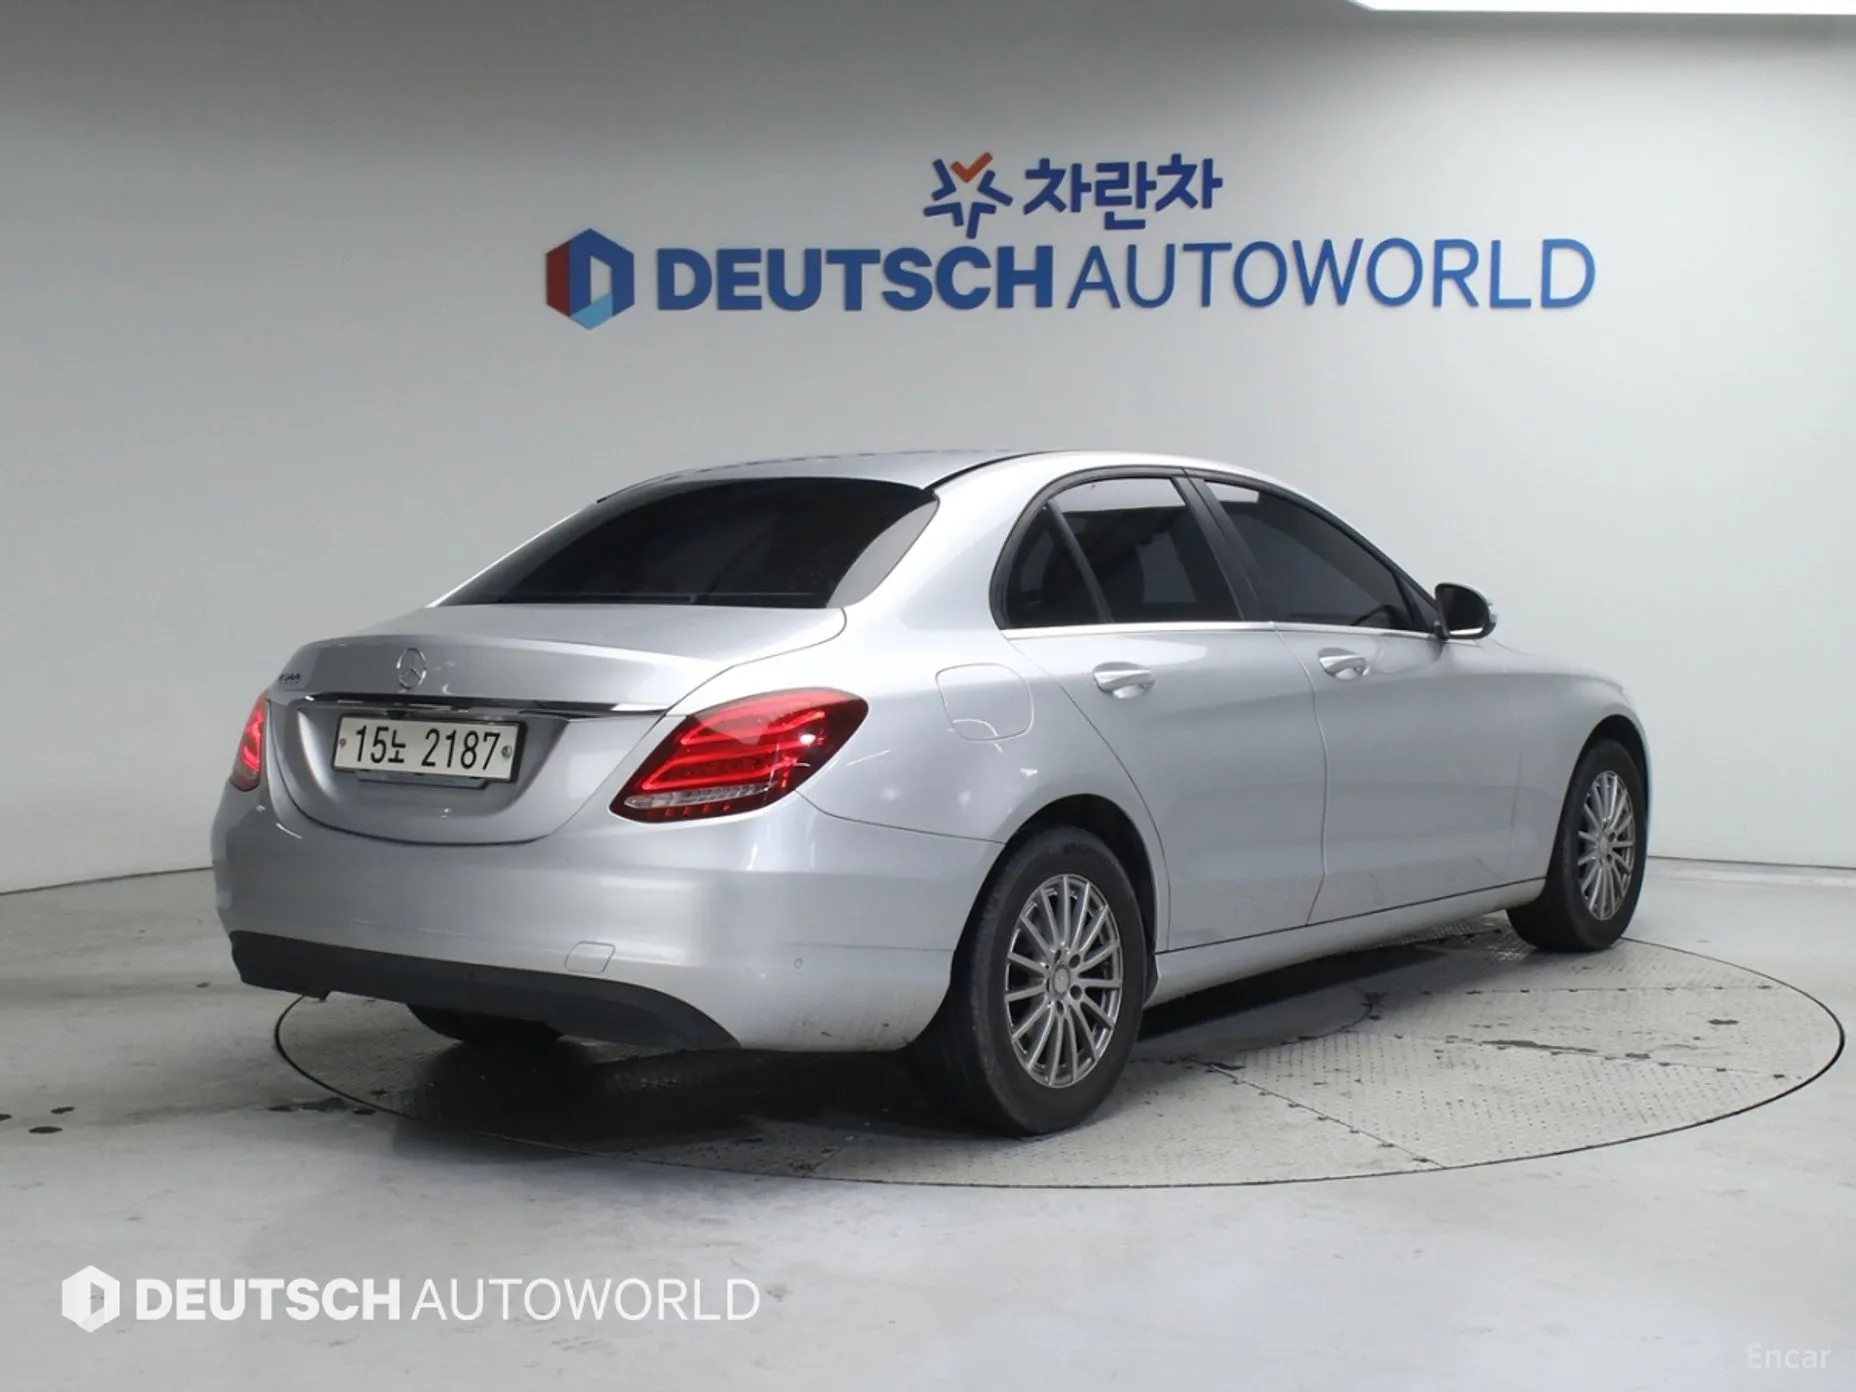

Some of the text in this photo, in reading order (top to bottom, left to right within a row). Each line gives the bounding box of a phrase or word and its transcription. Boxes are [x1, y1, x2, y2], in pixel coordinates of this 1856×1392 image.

[1023, 153, 1223, 230] 차란차
[656, 236, 1597, 311] DEUTSCH AUTOWORLD
[355, 725, 501, 770] 15노 2187
